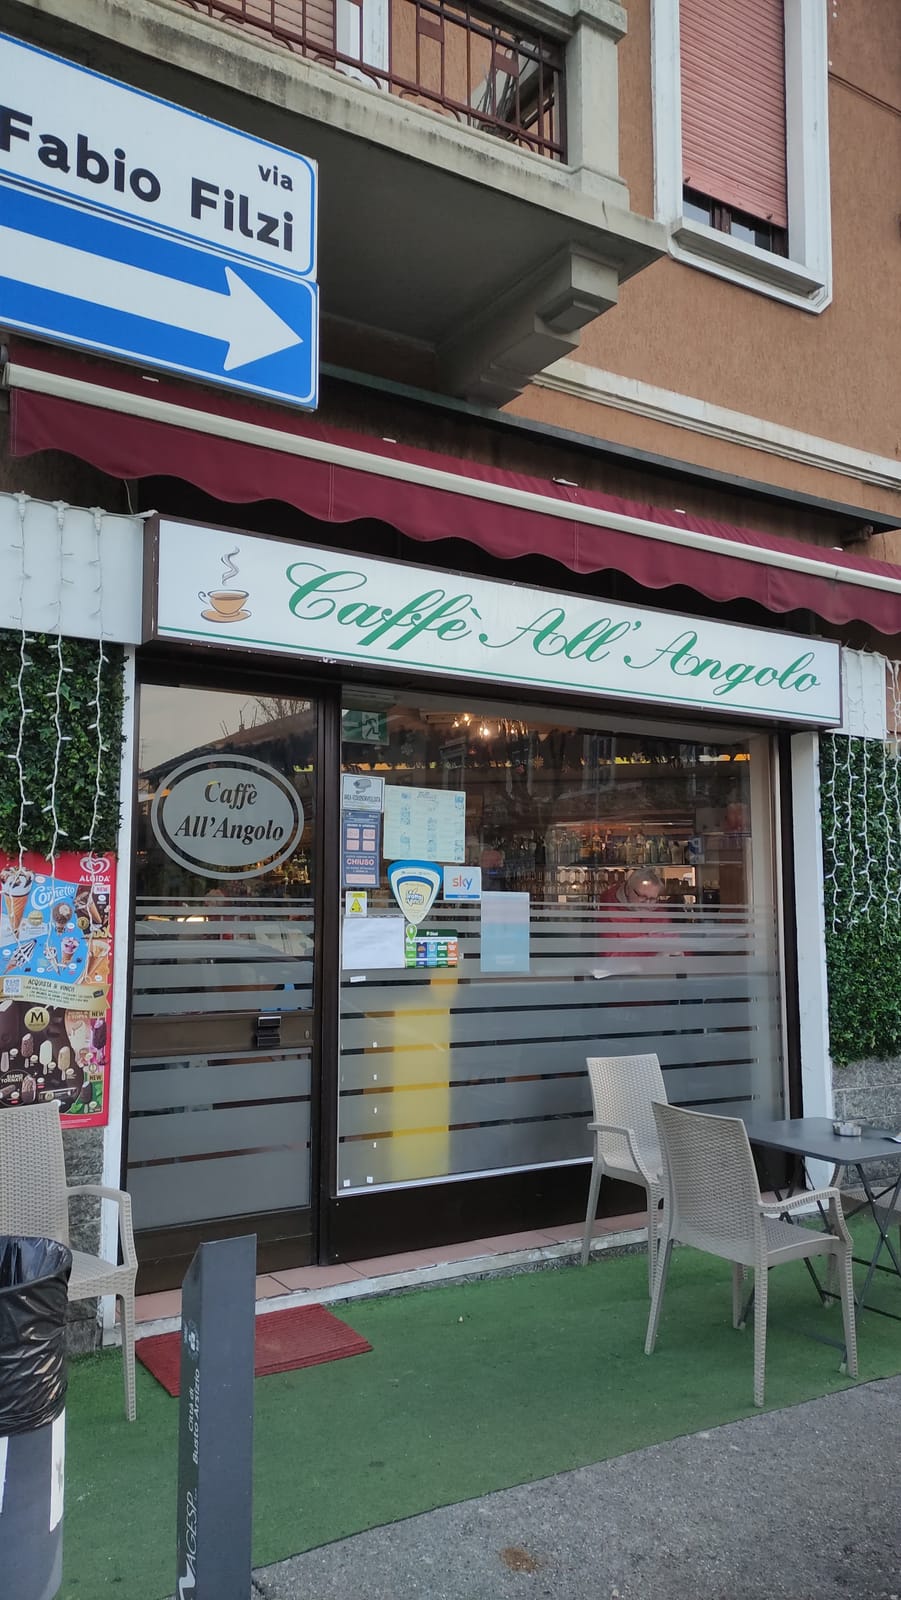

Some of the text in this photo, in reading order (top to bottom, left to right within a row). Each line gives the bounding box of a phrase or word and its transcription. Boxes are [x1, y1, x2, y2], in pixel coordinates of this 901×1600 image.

[0, 104, 294, 253] Fabio Filzi
[258, 164, 294, 192] via
[286, 561, 482, 651] Caffè
[204, 780, 258, 810] Caffè
[174, 815, 284, 845] All'Angolo
[452, 874, 473, 890] sky
[31, 885, 75, 910] Cornetto
[31, 1011, 43, 1023] M
[186, 1491, 197, 1576] AGESP
